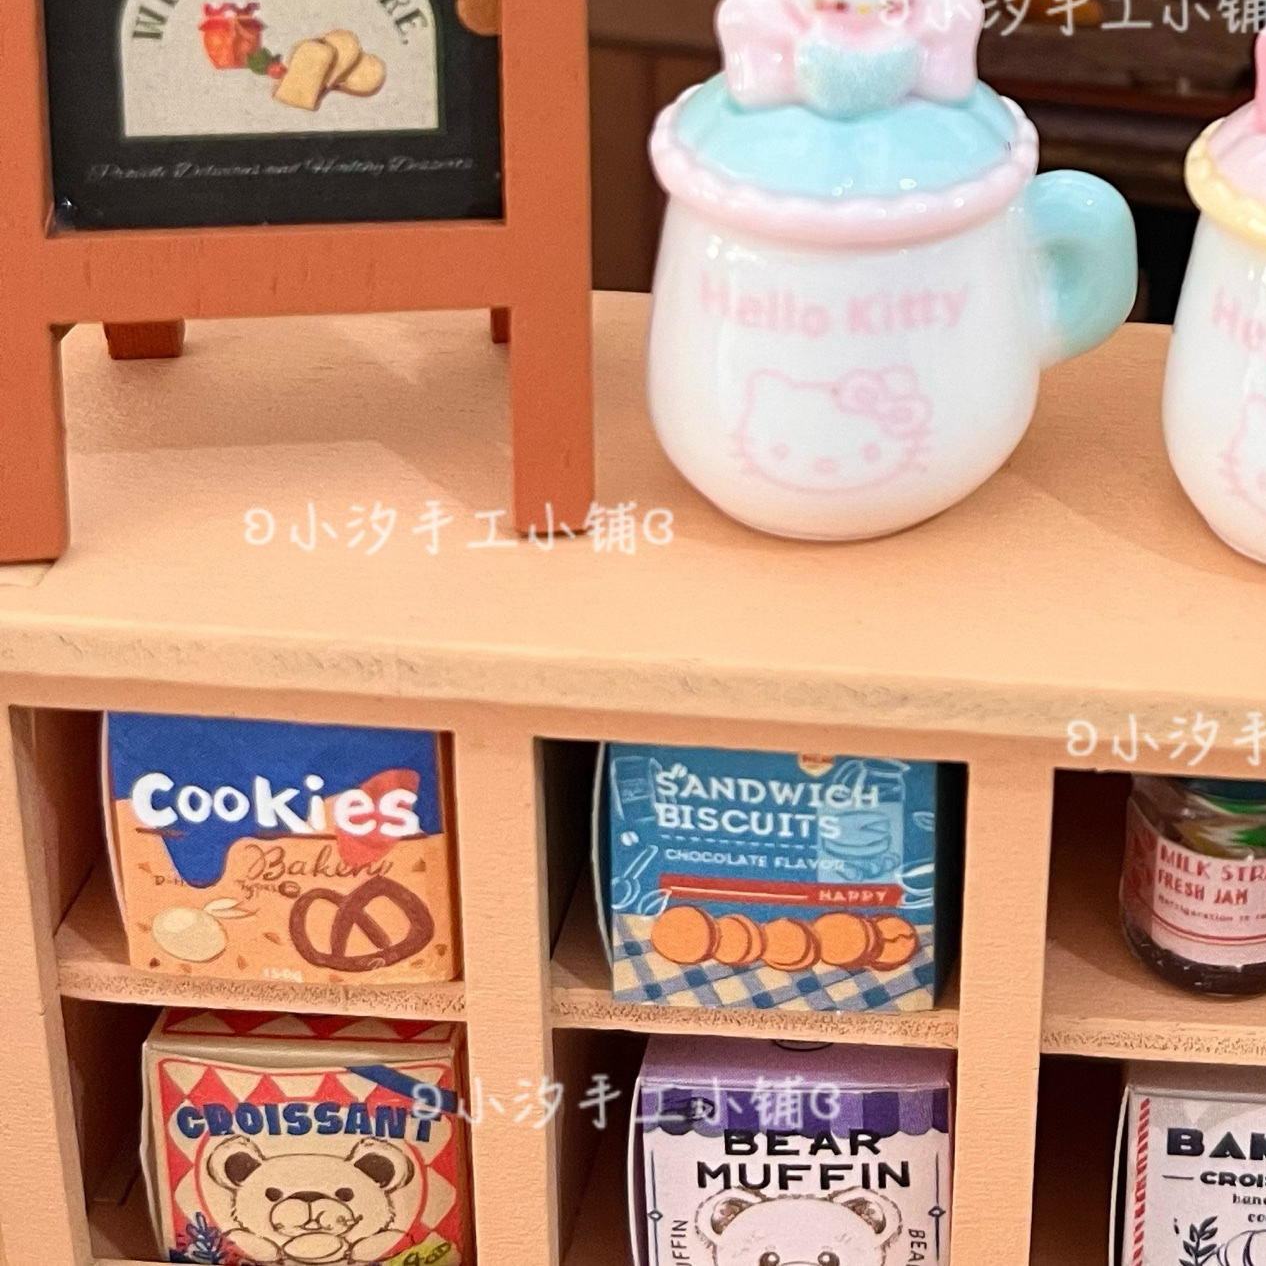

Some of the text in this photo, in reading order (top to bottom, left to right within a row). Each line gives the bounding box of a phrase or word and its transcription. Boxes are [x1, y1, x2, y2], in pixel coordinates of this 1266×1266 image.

[699, 269, 970, 340] Hello Kitty
[131, 771, 422, 837] Cookies
[656, 767, 880, 809] SANDWICH
[654, 802, 841, 840] BISCUITS
[664, 848, 768, 869] CHOCOLATE
[1161, 844, 1212, 880] MILK
[818, 888, 888, 904] HAPPY
[1159, 868, 1205, 901] FRESH
[1213, 887, 1248, 905] JAM
[177, 1102, 441, 1143] CROISSANT
[723, 1128, 882, 1156] BEAR
[696, 1161, 911, 1190] MUFFIN
